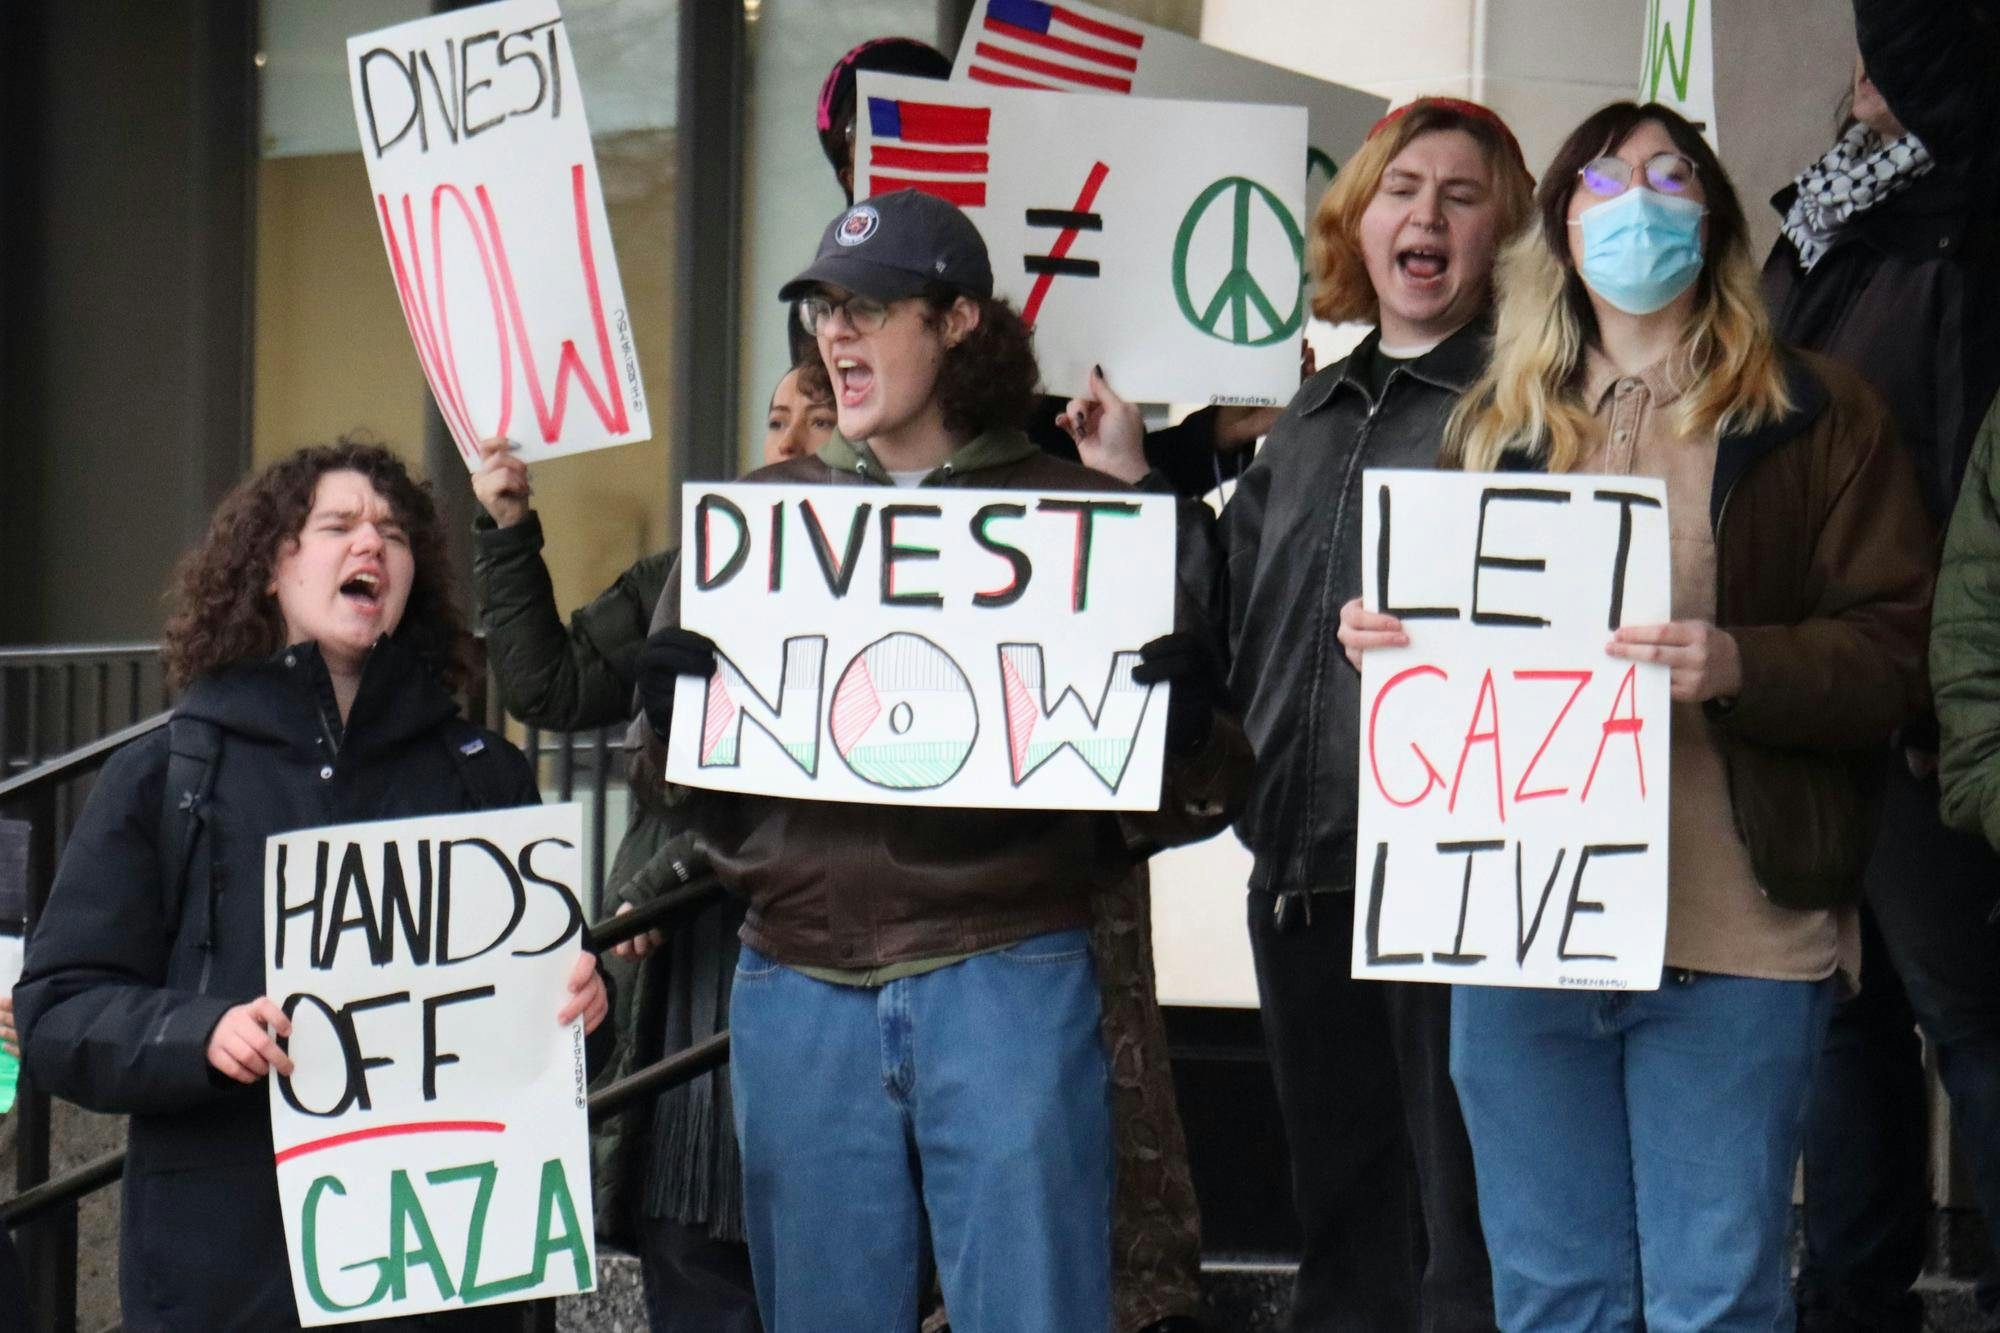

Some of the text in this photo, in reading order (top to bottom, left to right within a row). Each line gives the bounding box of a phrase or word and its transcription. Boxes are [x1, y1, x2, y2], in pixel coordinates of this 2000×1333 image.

[360, 18, 562, 158] DIVEST
[695, 494, 1142, 613] DIVEST
[1378, 485, 1662, 631] LET
[698, 632, 1154, 796] NOW
[1369, 664, 1647, 823] GAZA
[275, 837, 583, 970] HANDS
[1366, 839, 1648, 968] LIVE
[275, 985, 496, 1118] OFF
[301, 1159, 593, 1313] GAZA
